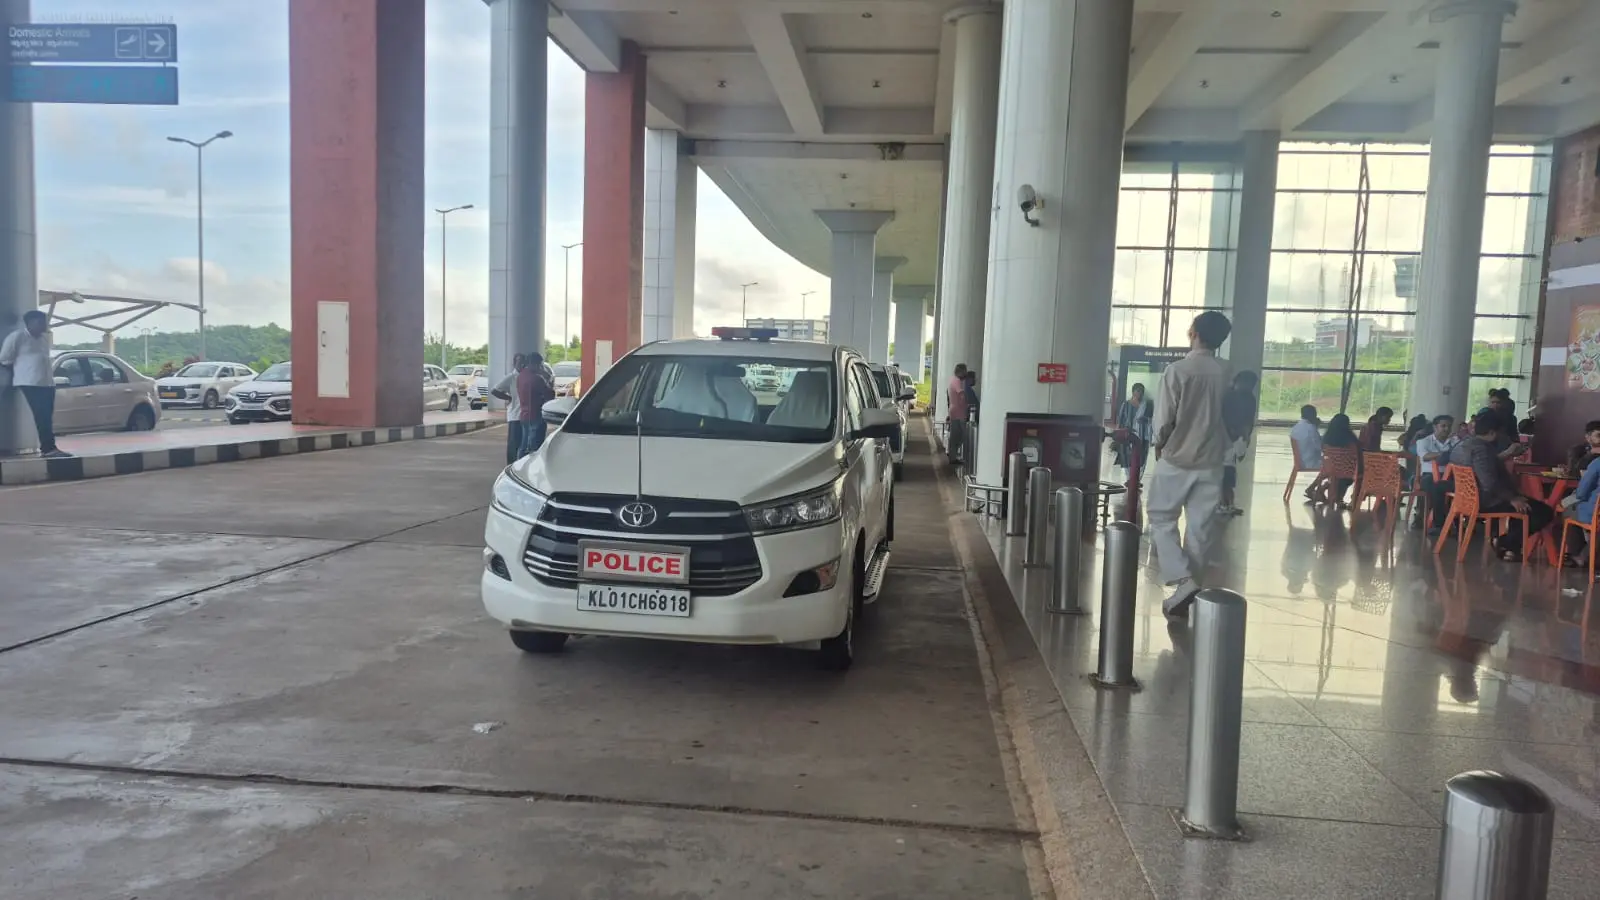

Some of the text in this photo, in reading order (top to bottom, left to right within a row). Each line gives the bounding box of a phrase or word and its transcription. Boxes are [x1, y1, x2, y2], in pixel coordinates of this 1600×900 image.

[9, 27, 53, 38] Domestic
[587, 551, 681, 575] POLICE
[588, 590, 688, 612] KL01CH6818
